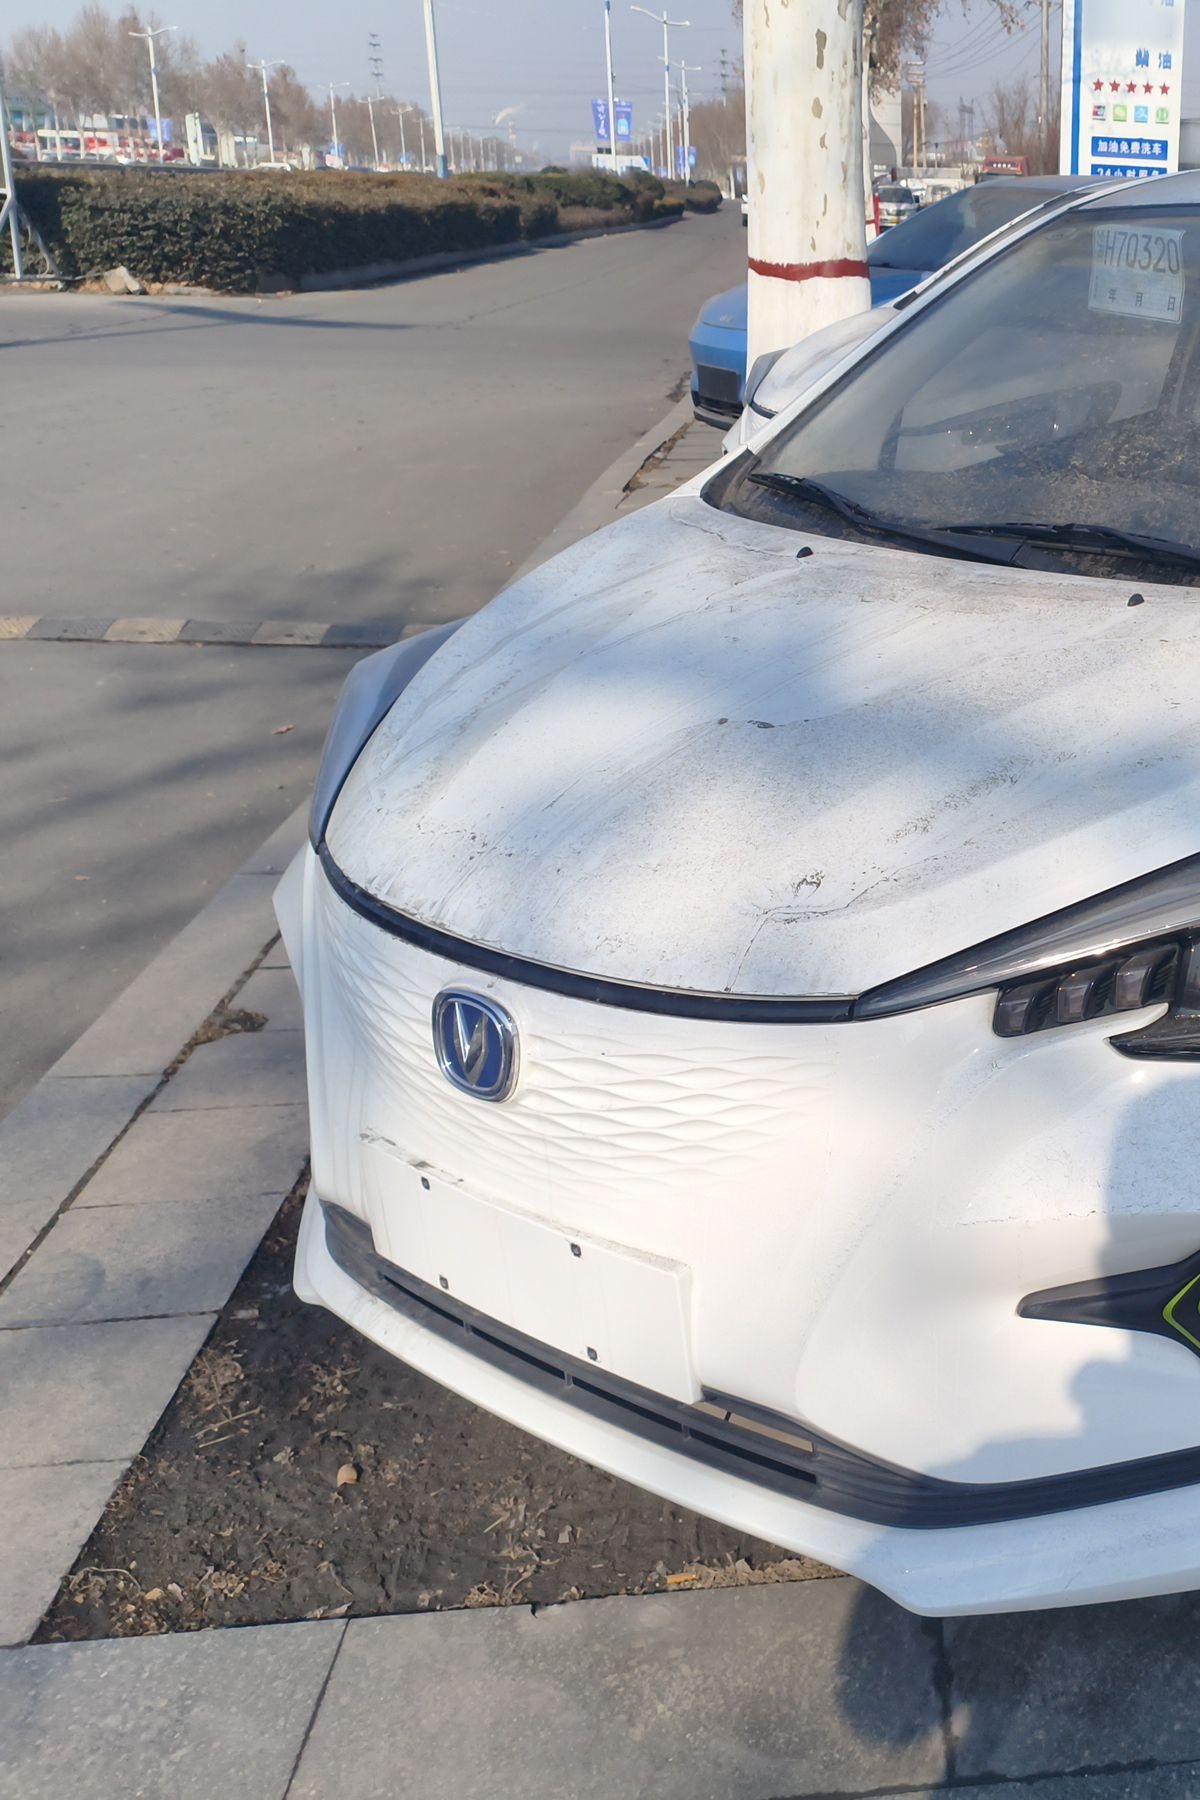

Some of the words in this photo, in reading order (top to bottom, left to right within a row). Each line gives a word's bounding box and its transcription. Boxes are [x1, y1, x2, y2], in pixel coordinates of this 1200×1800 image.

[1097, 139, 1162, 155] 加油免费洗车
[1104, 230, 1180, 275] H70320
[1135, 291, 1144, 307] 月
[1167, 296, 1176, 311] 日
